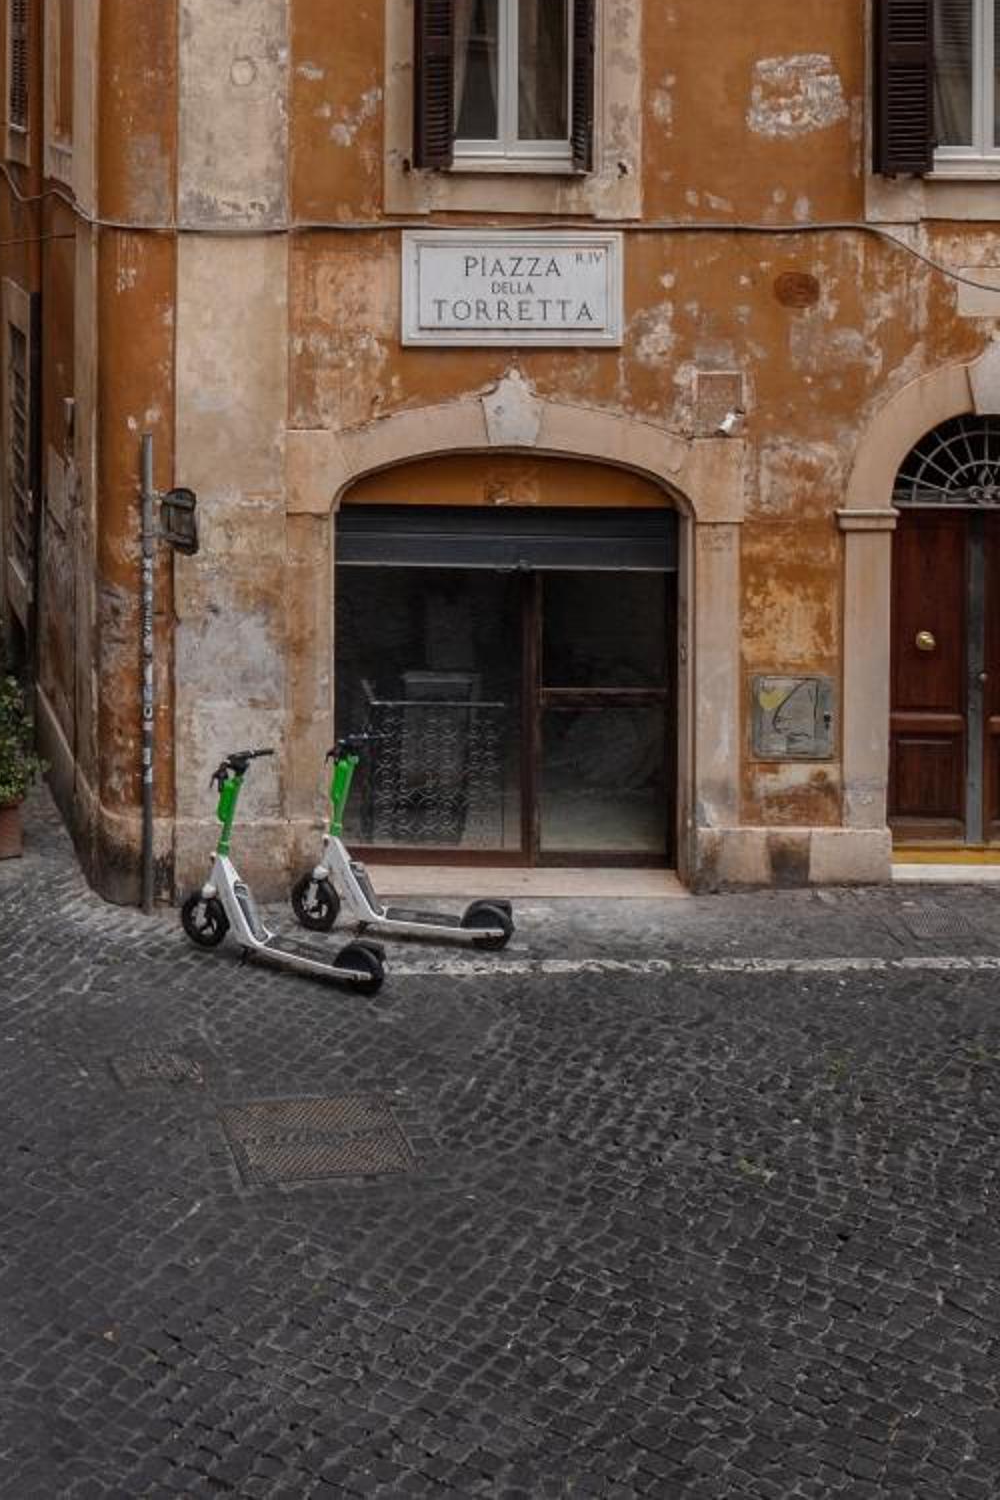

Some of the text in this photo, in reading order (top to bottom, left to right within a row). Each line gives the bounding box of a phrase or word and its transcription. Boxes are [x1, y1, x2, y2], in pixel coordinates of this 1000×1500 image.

[464, 256, 561, 277] PIAZZA
[491, 281, 534, 295] DELLA
[432, 299, 593, 322] TORRETTA
